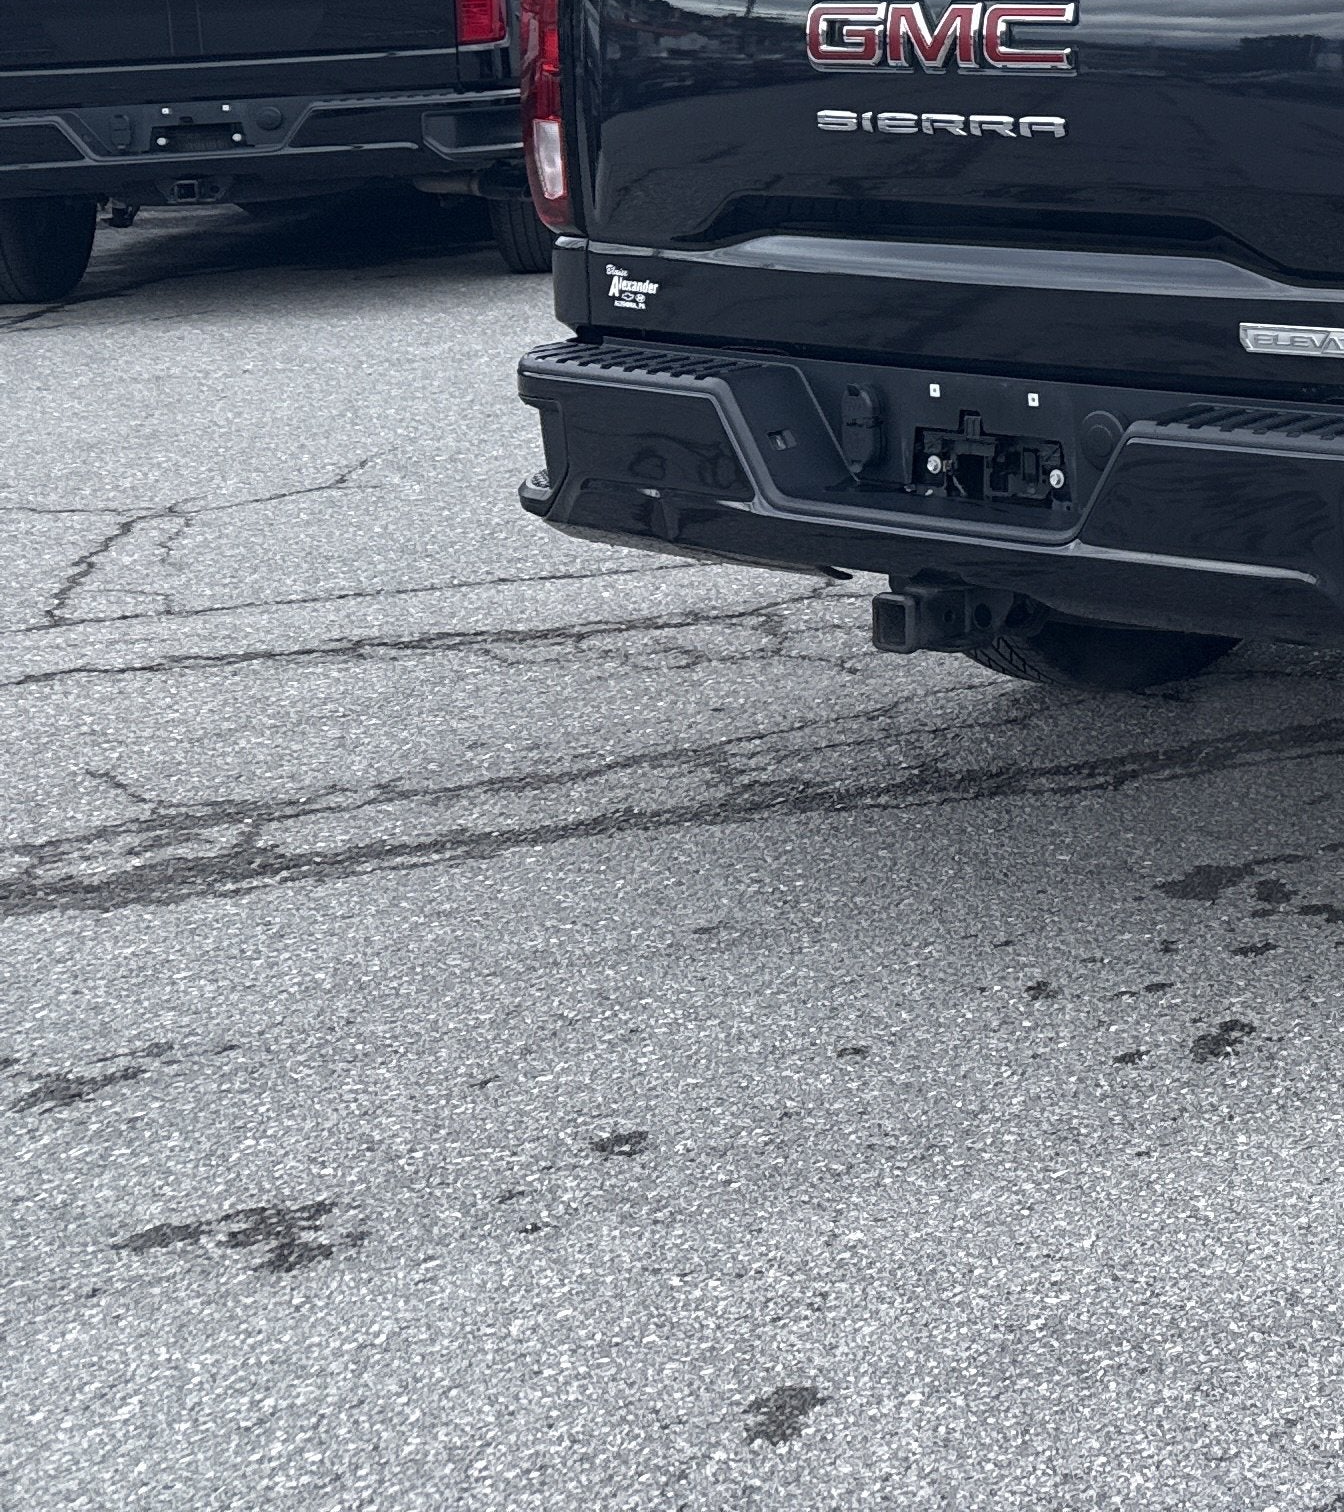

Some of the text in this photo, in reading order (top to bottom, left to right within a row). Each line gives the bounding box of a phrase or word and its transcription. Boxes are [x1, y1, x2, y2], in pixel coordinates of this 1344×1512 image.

[806, 0, 1076, 72] GMC
[816, 109, 1068, 138] SIERRA
[608, 275, 659, 297] Alexander
